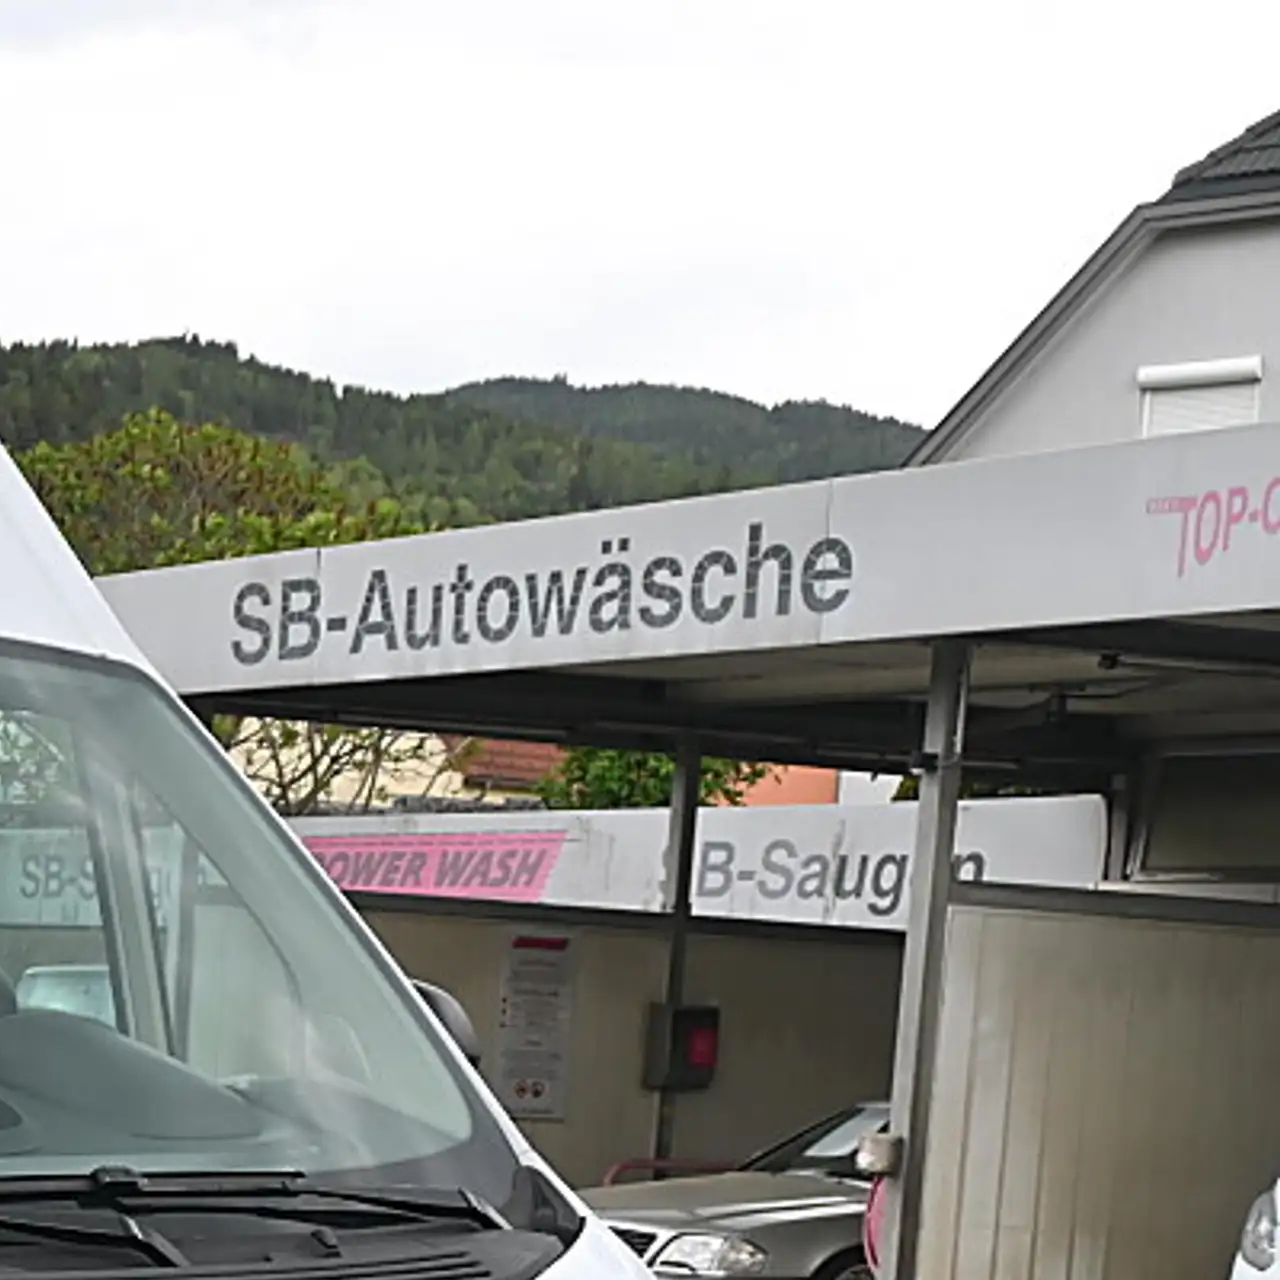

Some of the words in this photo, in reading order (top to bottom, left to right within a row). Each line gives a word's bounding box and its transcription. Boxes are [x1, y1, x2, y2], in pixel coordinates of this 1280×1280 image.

[232, 523, 853, 665] SB-Autowäsche
[434, 849, 546, 888] WASH
[659, 839, 984, 916] B-Saugn
